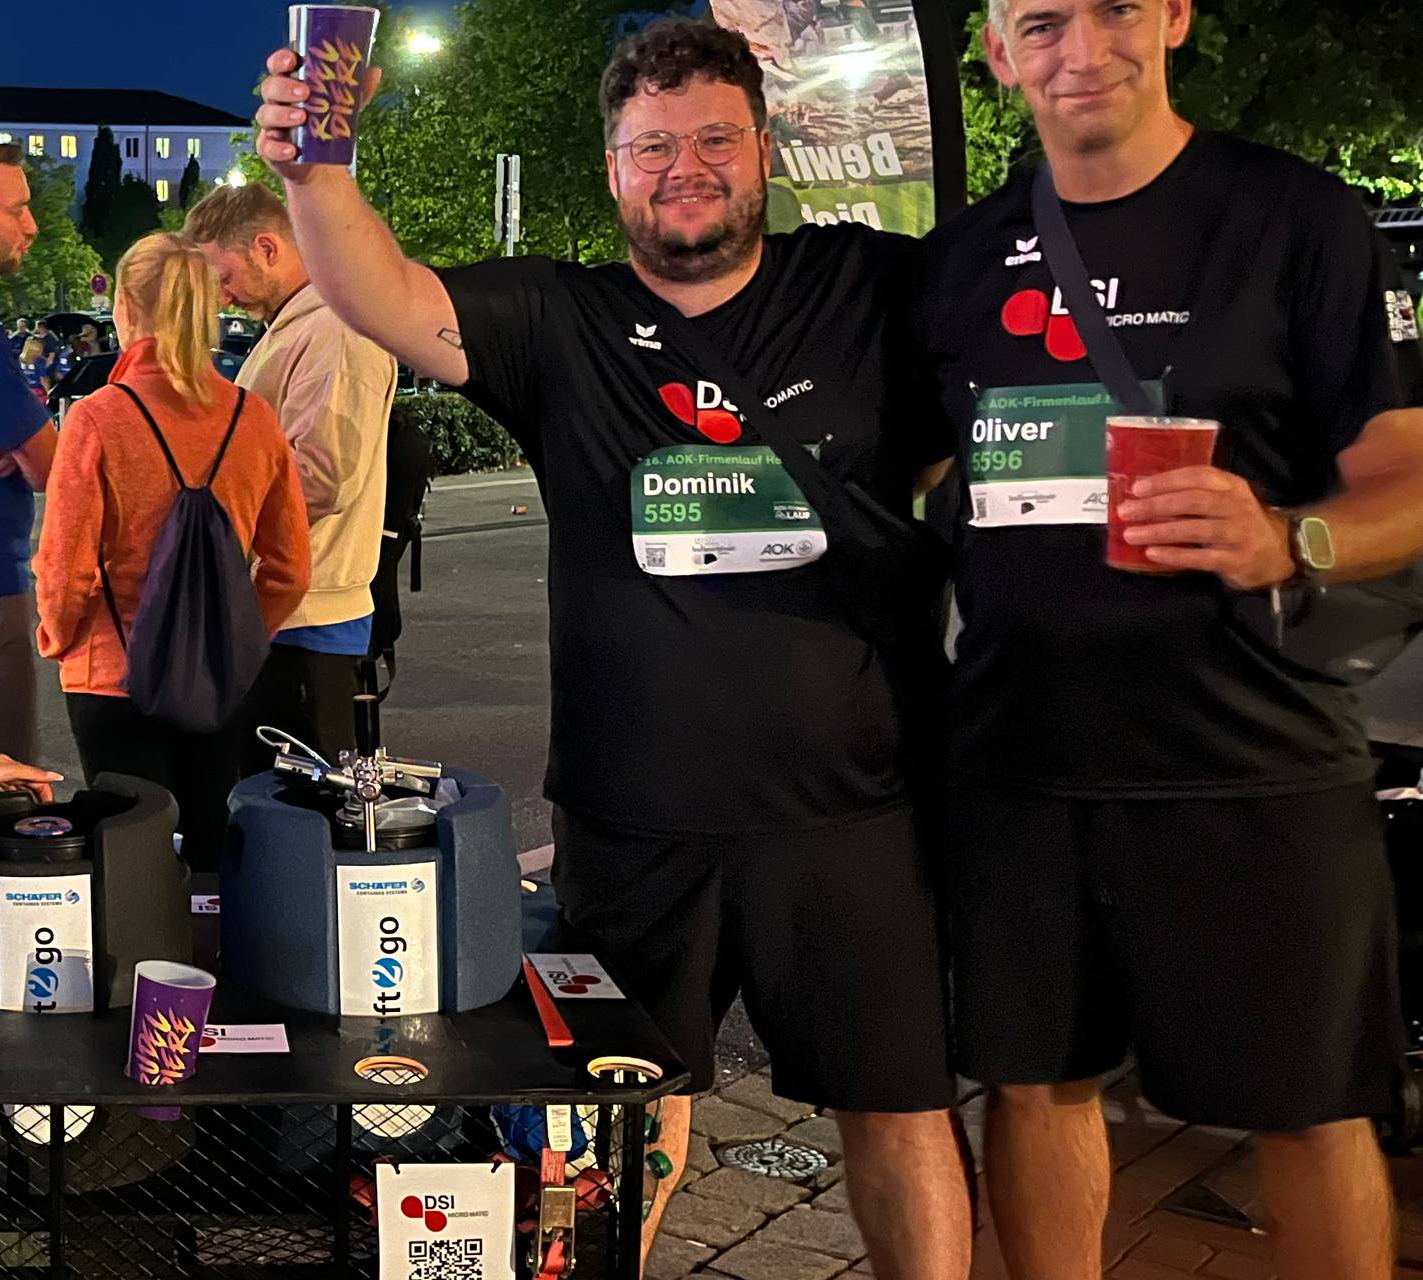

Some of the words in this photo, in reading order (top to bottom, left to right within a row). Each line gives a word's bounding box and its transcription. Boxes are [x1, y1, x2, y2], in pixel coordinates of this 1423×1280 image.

[1147, 311, 1190, 325] MATIC
[776, 379, 814, 404] MATIC
[972, 418, 1054, 443] Oliver
[665, 454, 763, 465] AOK-Firmenlauf
[971, 450, 1023, 472] 5596
[643, 472, 756, 497] Dominik
[1083, 492, 1109, 505] AO
[644, 502, 702, 524] 5595
[761, 543, 795, 555] AOK
[372, 916, 407, 1017] ft2go
[204, 1027, 227, 1037] SI
[424, 1195, 455, 1210] DSI
